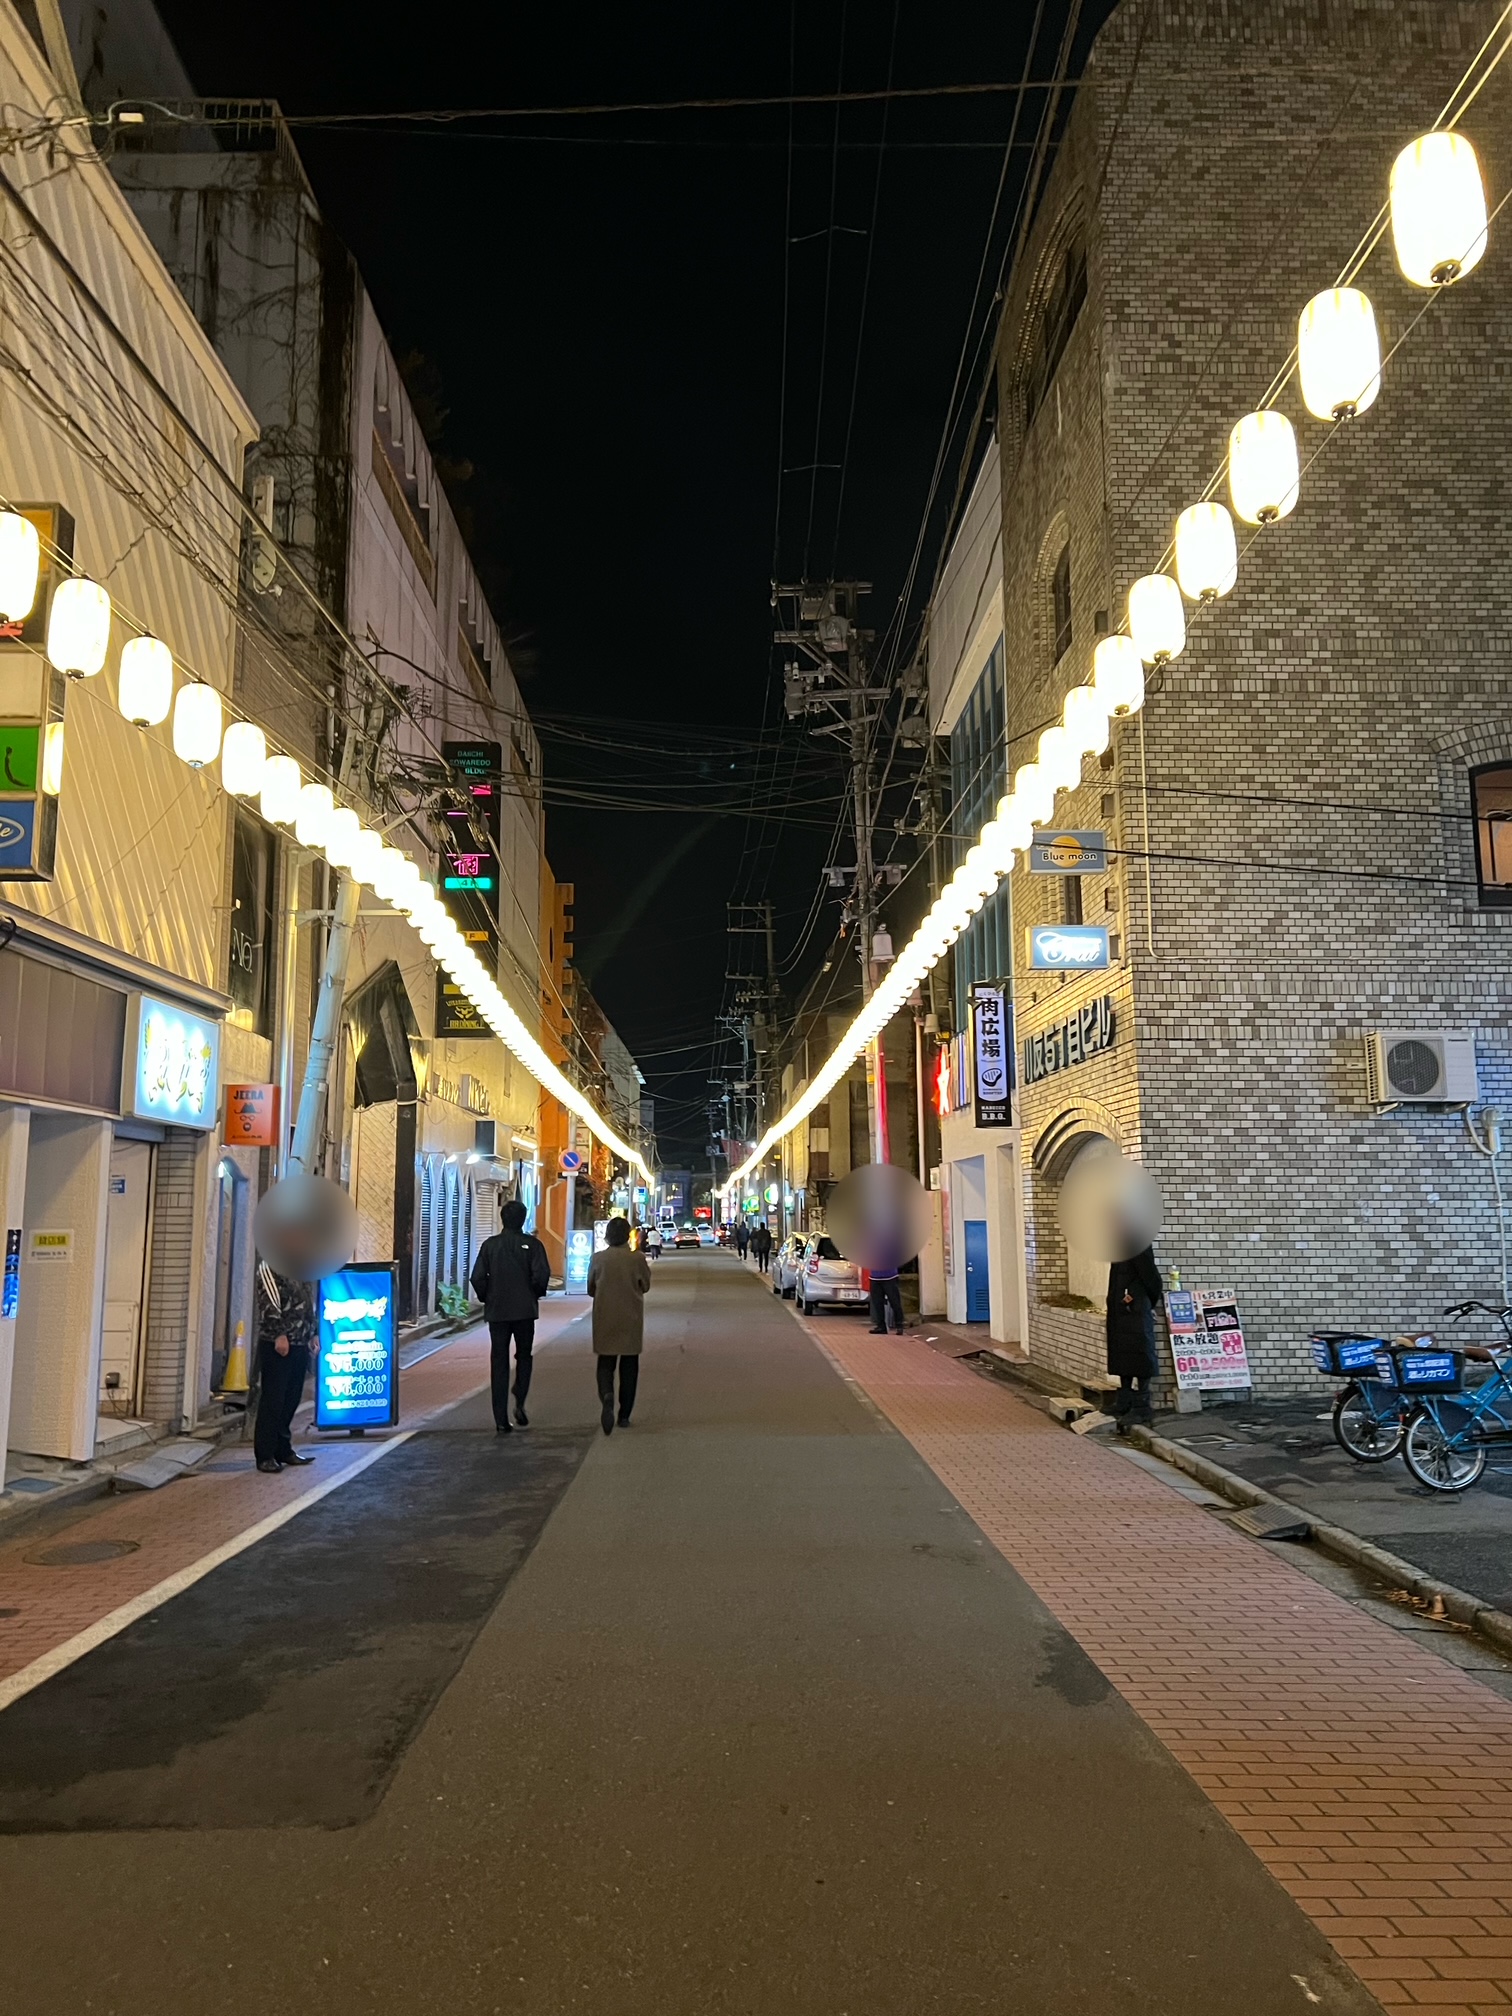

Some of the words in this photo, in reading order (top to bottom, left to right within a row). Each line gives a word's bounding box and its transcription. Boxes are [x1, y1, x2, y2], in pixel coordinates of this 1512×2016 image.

[1042, 852, 1064, 861] Blue
[1068, 852, 1097, 861] moon
[981, 998, 1000, 1057] 肉広場
[233, 1090, 264, 1100] JEERA
[1174, 1332, 1219, 1346] 飲み放題
